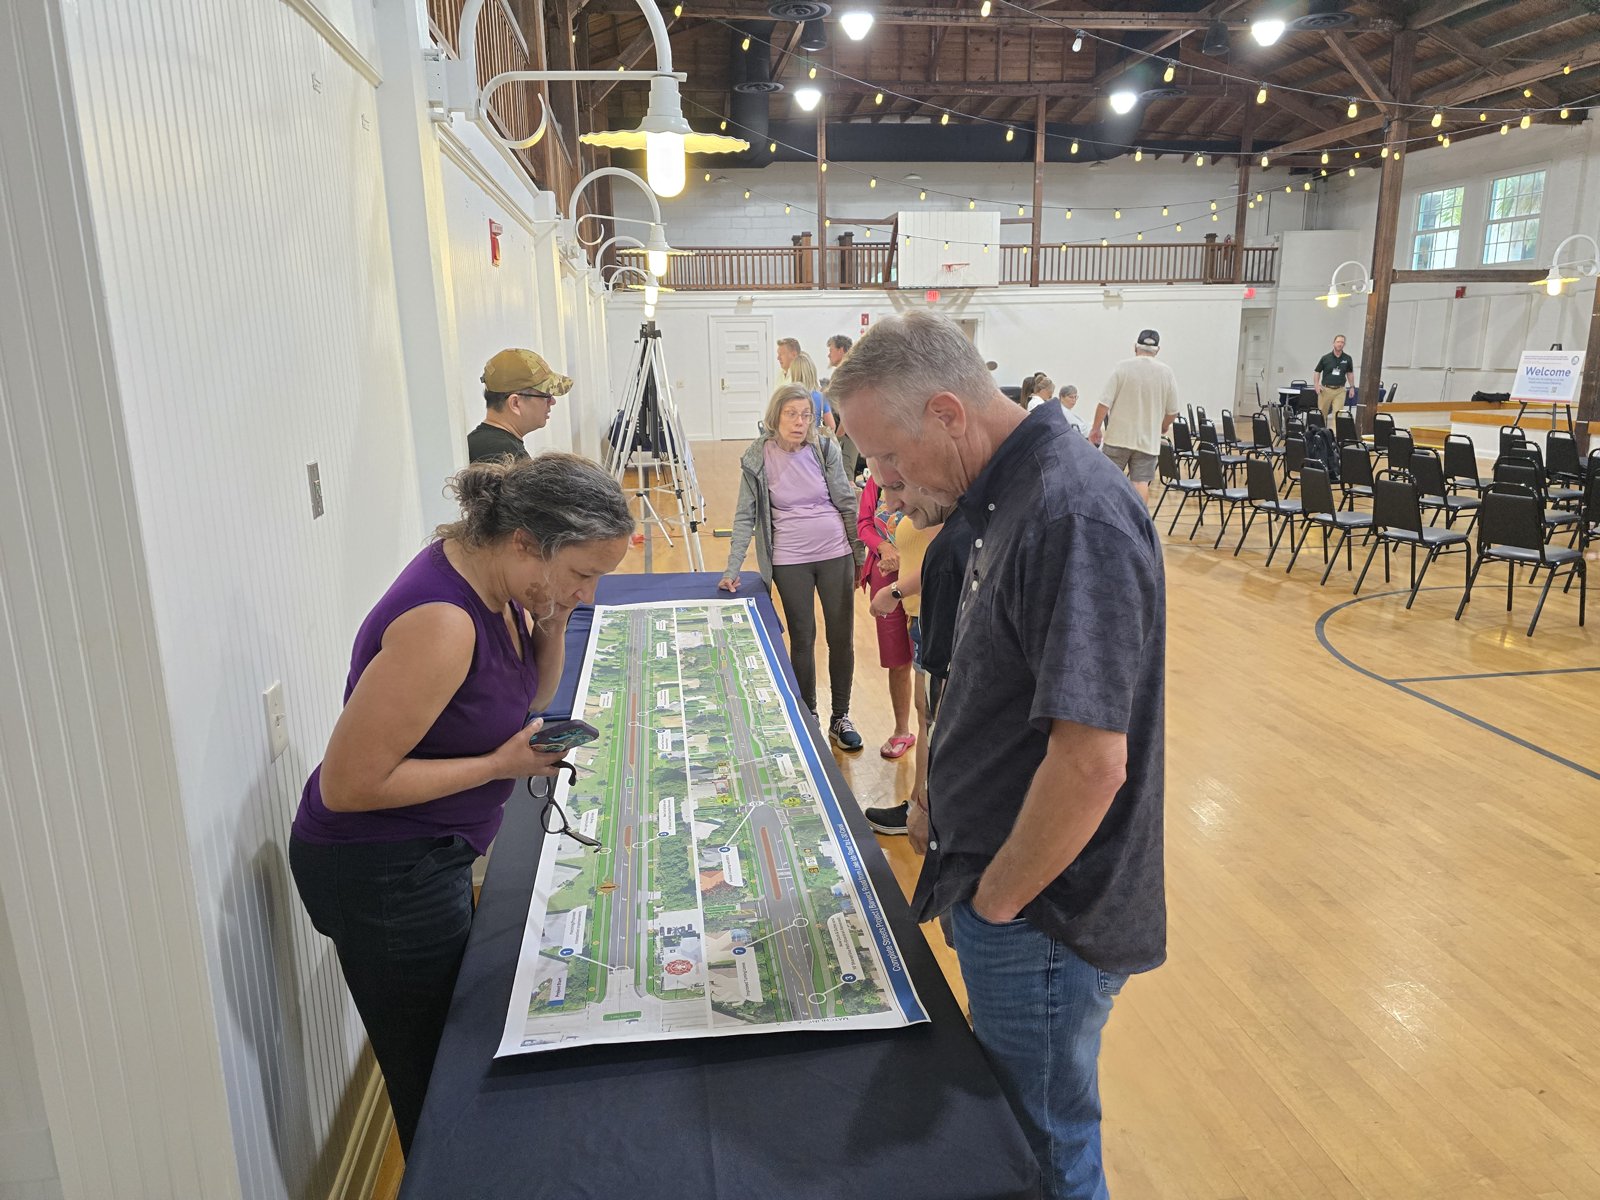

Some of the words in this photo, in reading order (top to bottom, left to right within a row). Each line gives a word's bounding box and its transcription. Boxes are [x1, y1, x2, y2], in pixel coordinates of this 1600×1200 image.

[1526, 366, 1571, 377] Welcome
[837, 824, 846, 833] Canal
[857, 870, 865, 881] from
[861, 880, 869, 891] Road
[864, 892, 876, 908] Barwick
[872, 911, 884, 928] Project
[879, 928, 891, 946] Streets
[886, 946, 900, 972] Complete
